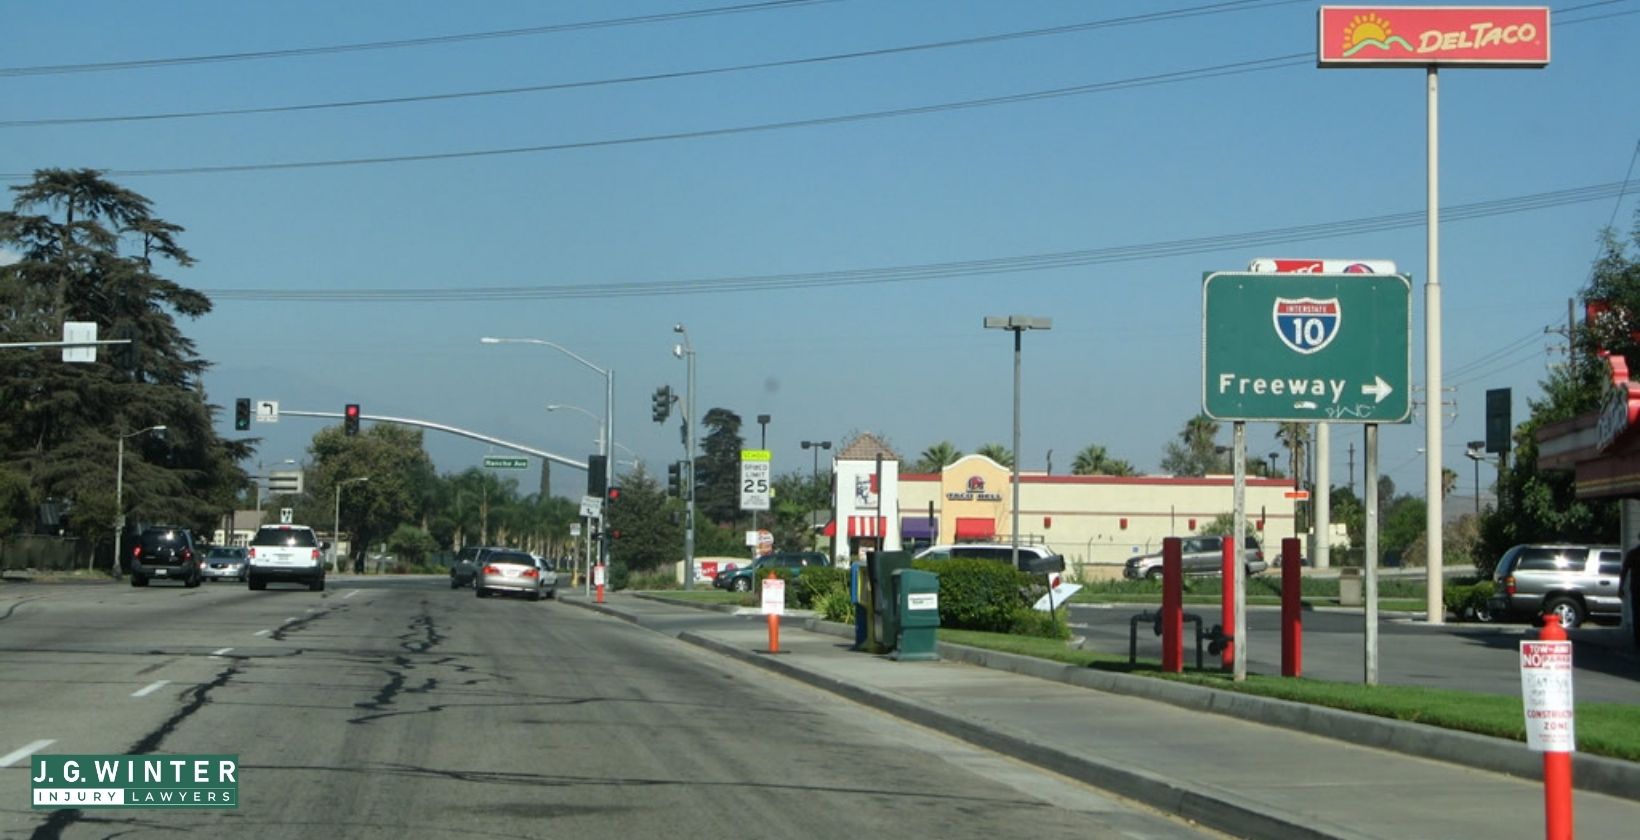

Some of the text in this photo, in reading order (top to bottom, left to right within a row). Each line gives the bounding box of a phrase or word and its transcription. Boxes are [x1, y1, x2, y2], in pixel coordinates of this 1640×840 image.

[1286, 305, 1327, 313] INTERSTATE
[1293, 318, 1325, 346] 10
[1219, 373, 1346, 403] Freeway
[744, 479, 768, 493] 25
[1524, 654, 1542, 667] NO
